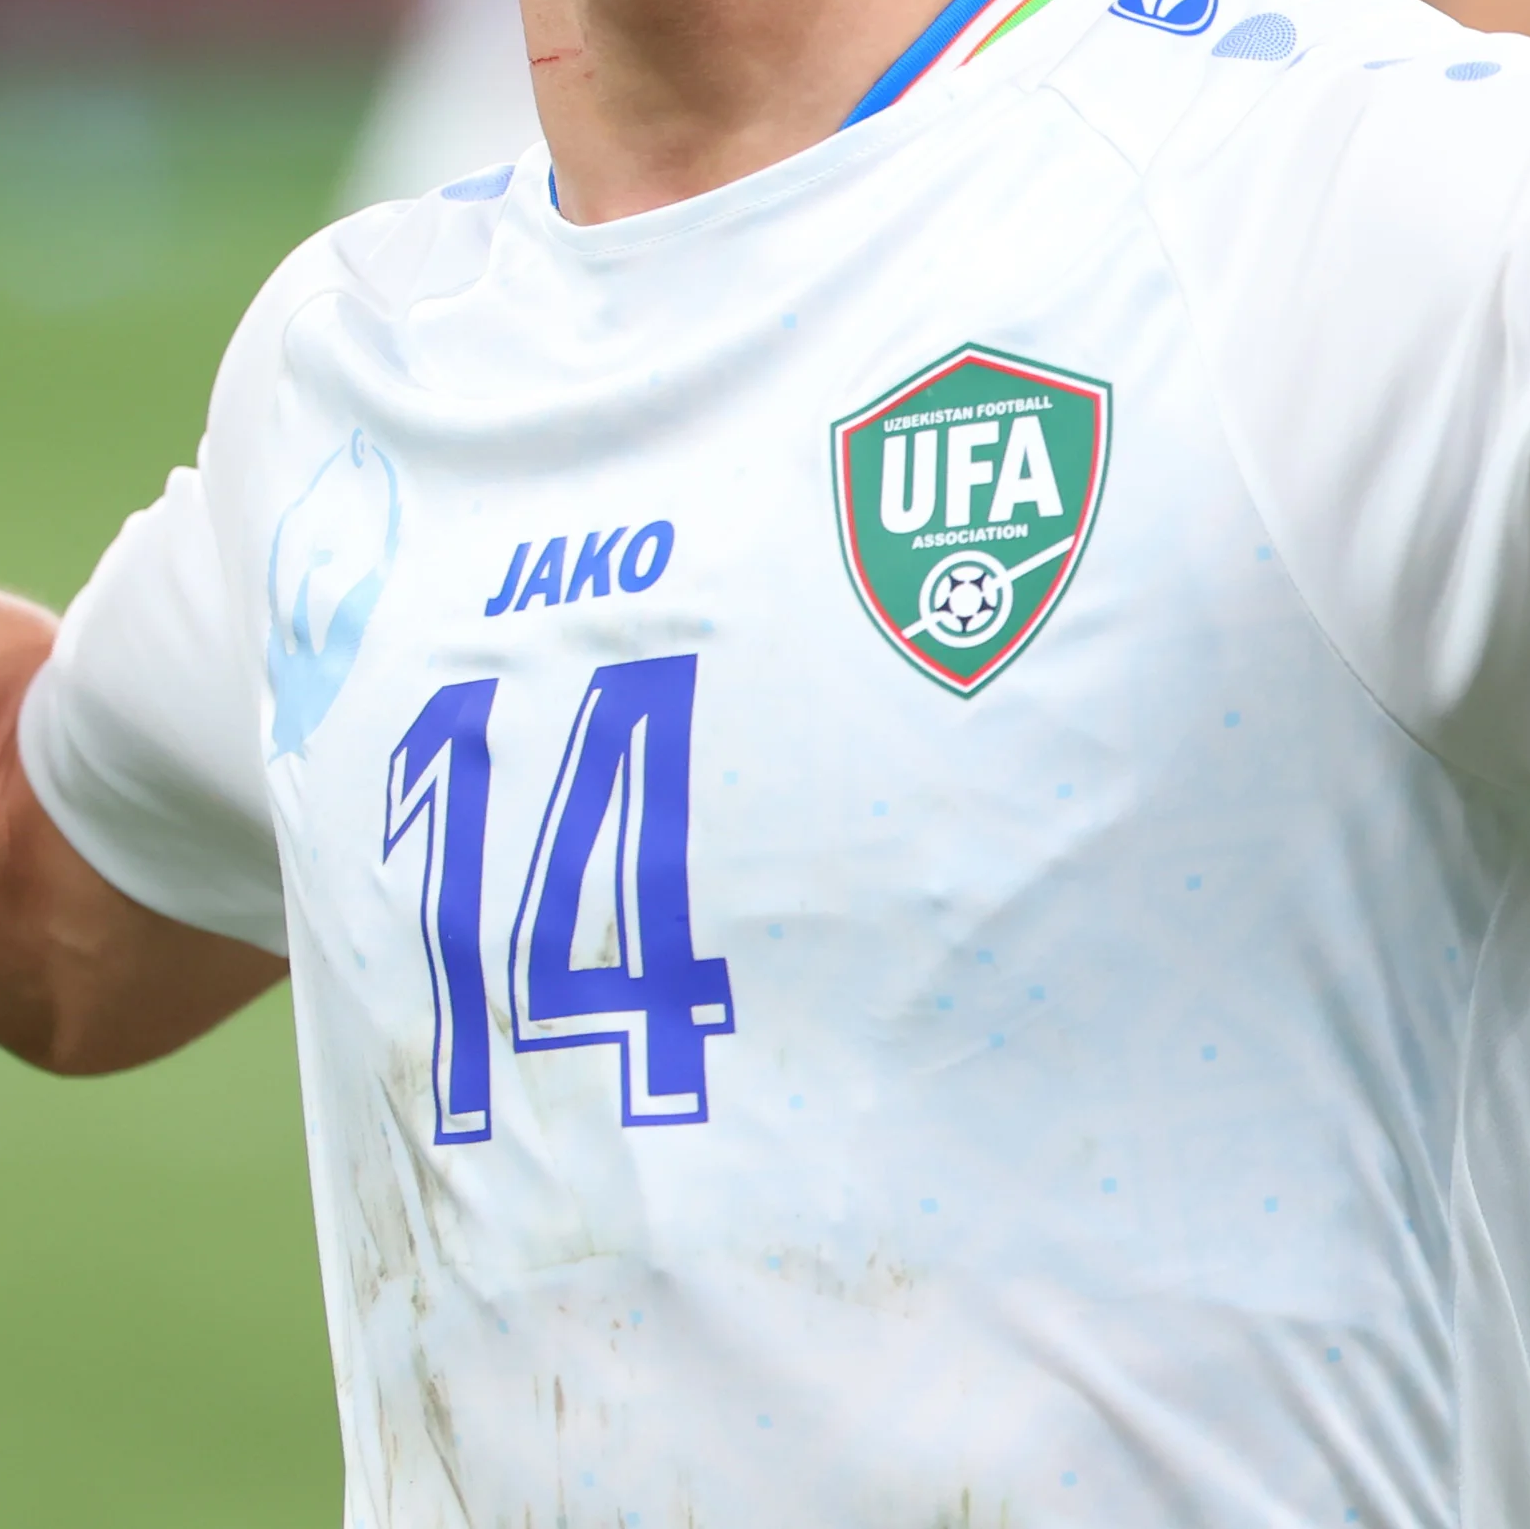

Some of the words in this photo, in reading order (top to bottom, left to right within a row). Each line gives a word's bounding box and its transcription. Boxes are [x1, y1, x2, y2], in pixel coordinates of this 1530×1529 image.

[884, 406, 973, 432] UZBEKISTAN
[976, 395, 1053, 417] FOOTBALL
[880, 415, 1064, 534] UFA
[484, 520, 675, 616] JAKO
[912, 524, 1028, 549] ASSOCIATION
[383, 653, 736, 1145] 14
